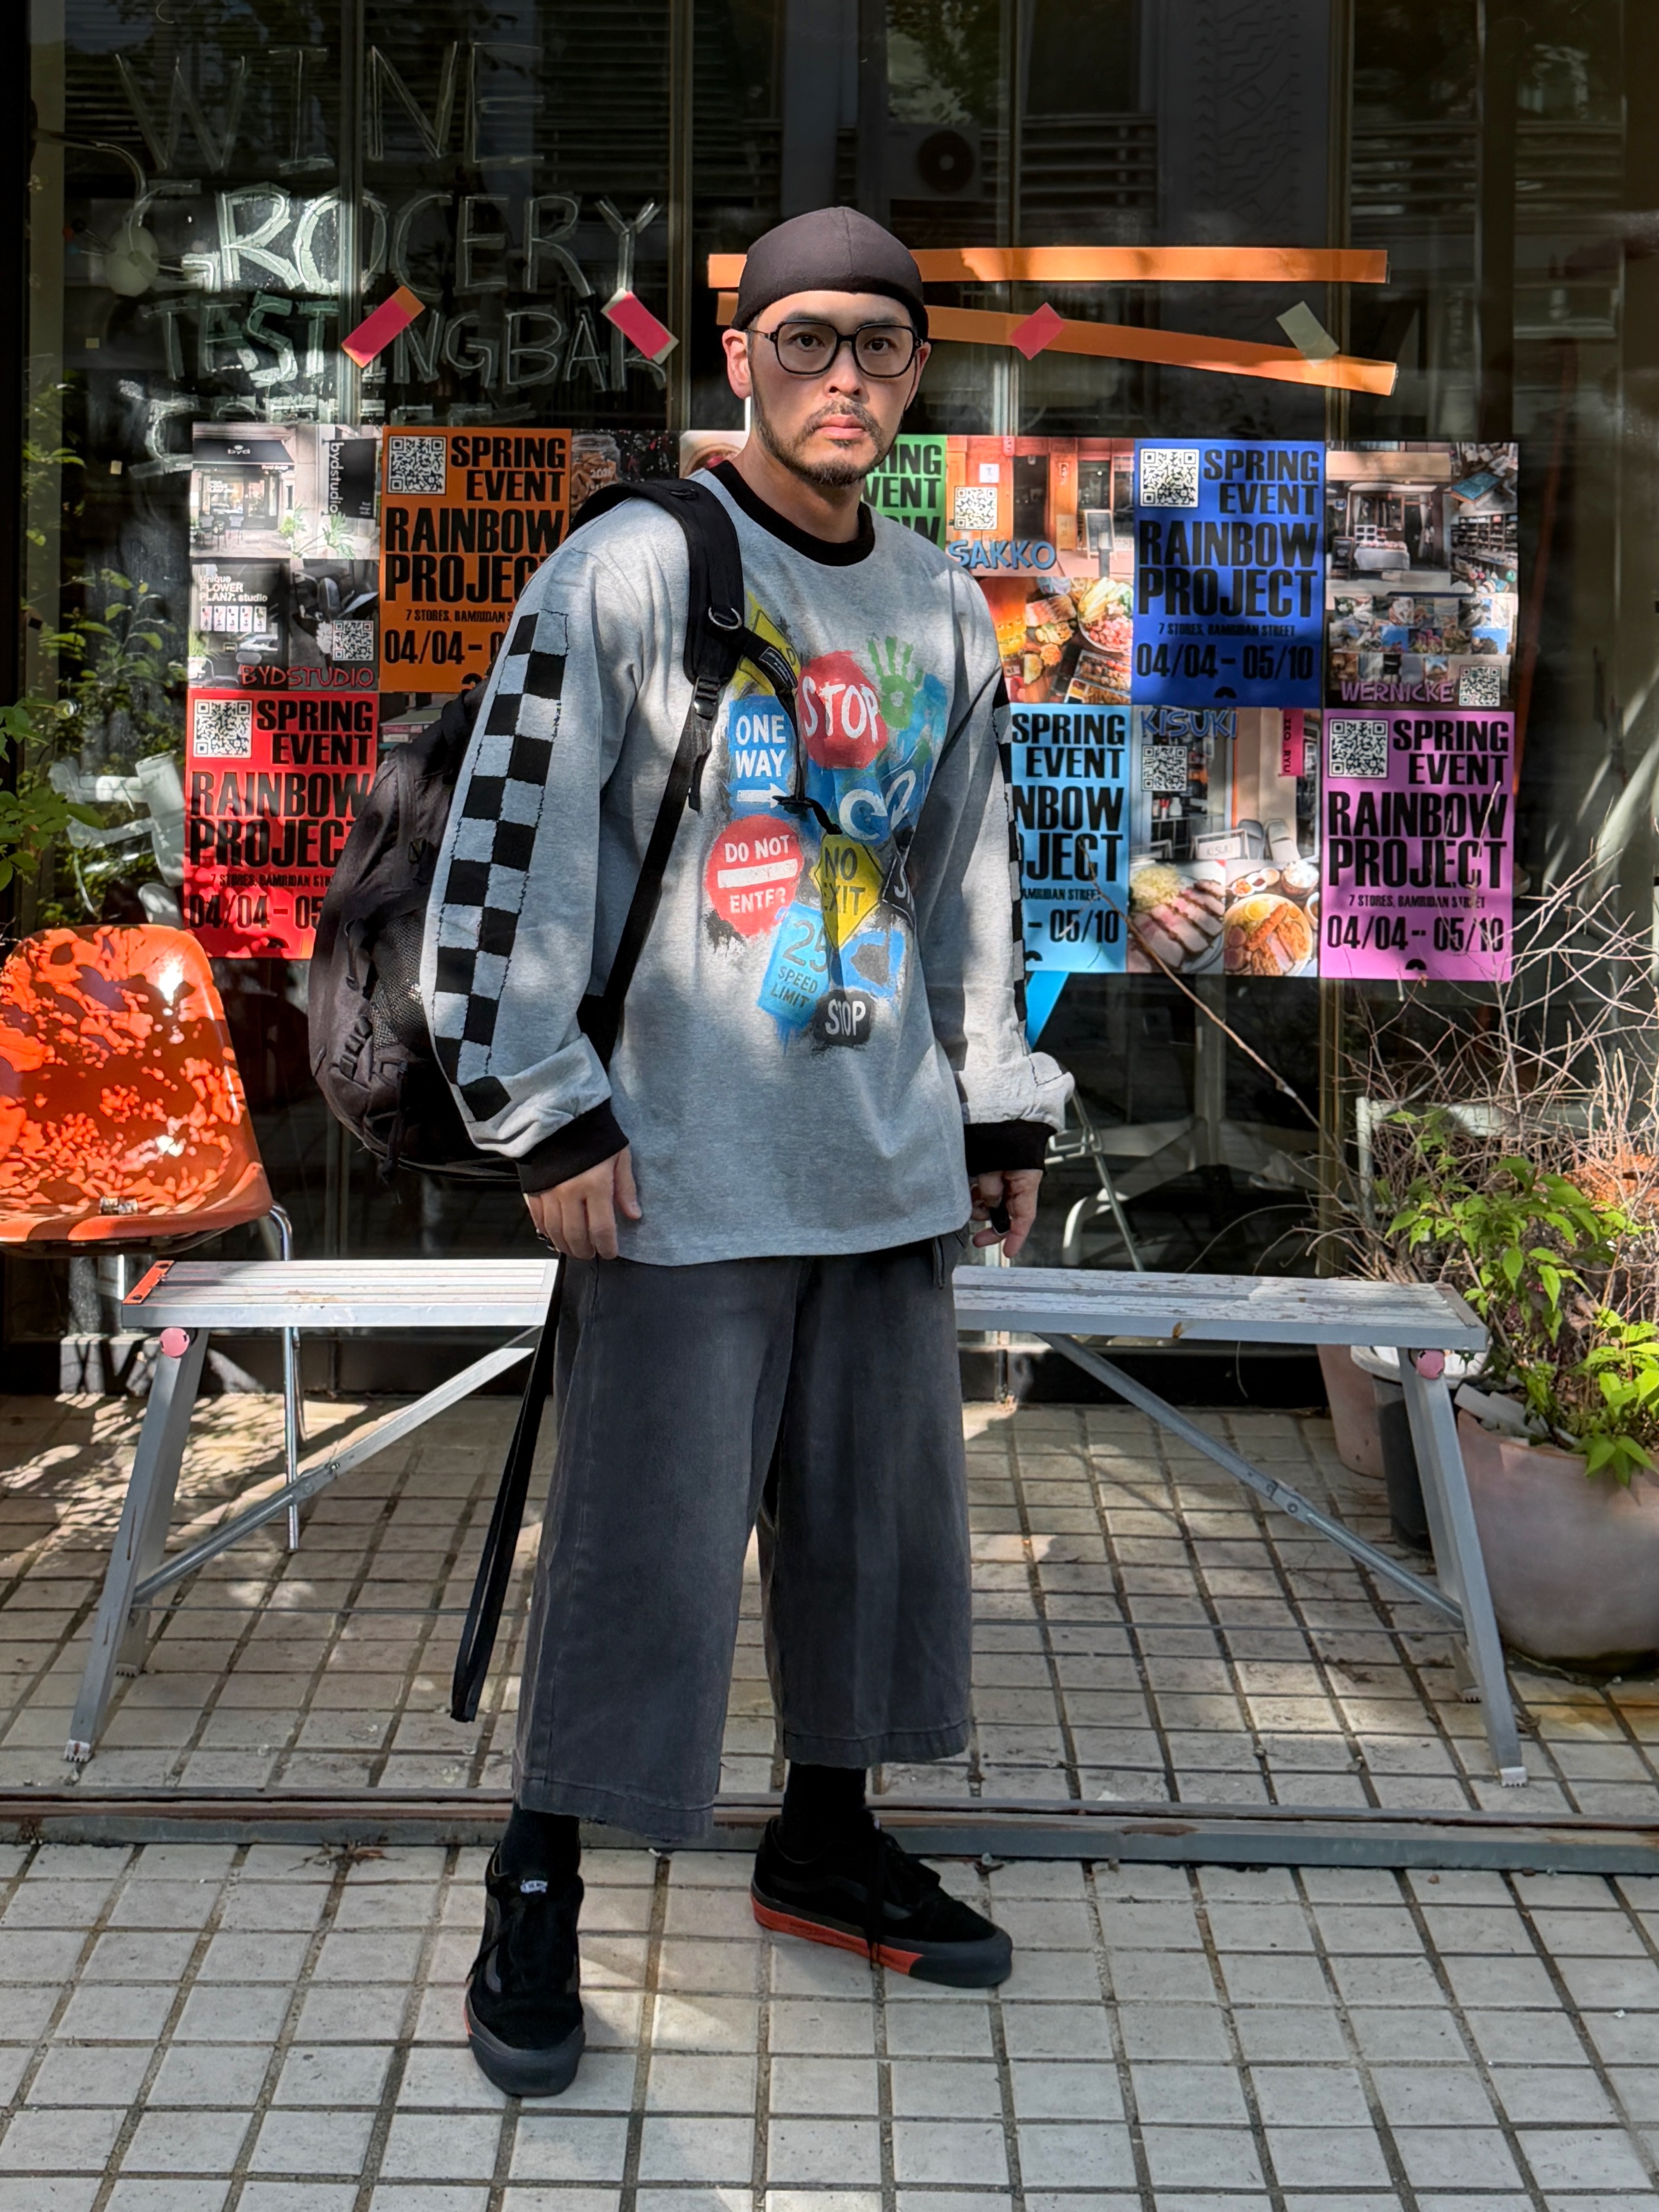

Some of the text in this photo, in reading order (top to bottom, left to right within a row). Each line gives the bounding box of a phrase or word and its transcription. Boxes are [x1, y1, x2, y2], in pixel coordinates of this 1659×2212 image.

[128, 179, 663, 300] GROCERY
[451, 436, 566, 469] SPRING
[1204, 449, 1320, 482] SPRING
[329, 441, 345, 514] bydstudio
[466, 469, 566, 502] EVENT
[1220, 483, 1318, 515] EVENT
[385, 507, 564, 554] RAINBOW
[1139, 520, 1319, 568] RAINBOW
[948, 540, 1057, 569] SAKKO
[200, 574, 231, 585] Unique
[200, 583, 243, 592] FLOWER
[385, 554, 553, 603] PROJEC
[1138, 567, 1317, 618] PROJECT
[238, 593, 268, 602] studio
[406, 609, 411, 621] 7
[1159, 623, 1165, 635] 7
[1261, 624, 1295, 637] STREET
[384, 629, 465, 665] 04/04
[1137, 643, 1218, 679] 04/04
[1243, 645, 1314, 680] 05/10
[240, 664, 374, 687] BYDSTUDIO
[1341, 681, 1454, 702] WERNICKE
[257, 699, 373, 732] SPRING
[801, 675, 880, 744] STOP
[1140, 708, 1237, 739] KISUKI
[735, 714, 786, 745] ONE
[1012, 713, 1125, 745] SPRING
[1392, 720, 1509, 753] SPRING
[272, 733, 372, 765] EVENT
[735, 749, 786, 779] WAY
[1026, 746, 1125, 779] EVENT
[1408, 754, 1508, 786] EVENT
[191, 771, 370, 818] RAINBOW
[1328, 791, 1508, 838] RAINBOW
[190, 819, 355, 868] PROJEC
[725, 835, 789, 863] DO NOT
[1018, 832, 1123, 882] JECT
[824, 846, 858, 881] NO
[1328, 839, 1507, 890] PROJECT
[189, 895, 270, 929] 04/04
[1349, 895, 1356, 906] 7
[1452, 896, 1486, 908] STRET
[1050, 908, 1119, 944] 05/10
[1327, 915, 1409, 951] 04/04
[1433, 917, 1504, 952] 05/10
[782, 920, 828, 973] 25
[770, 982, 810, 1008] LIMIT
[778, 965, 818, 994] SPEED
